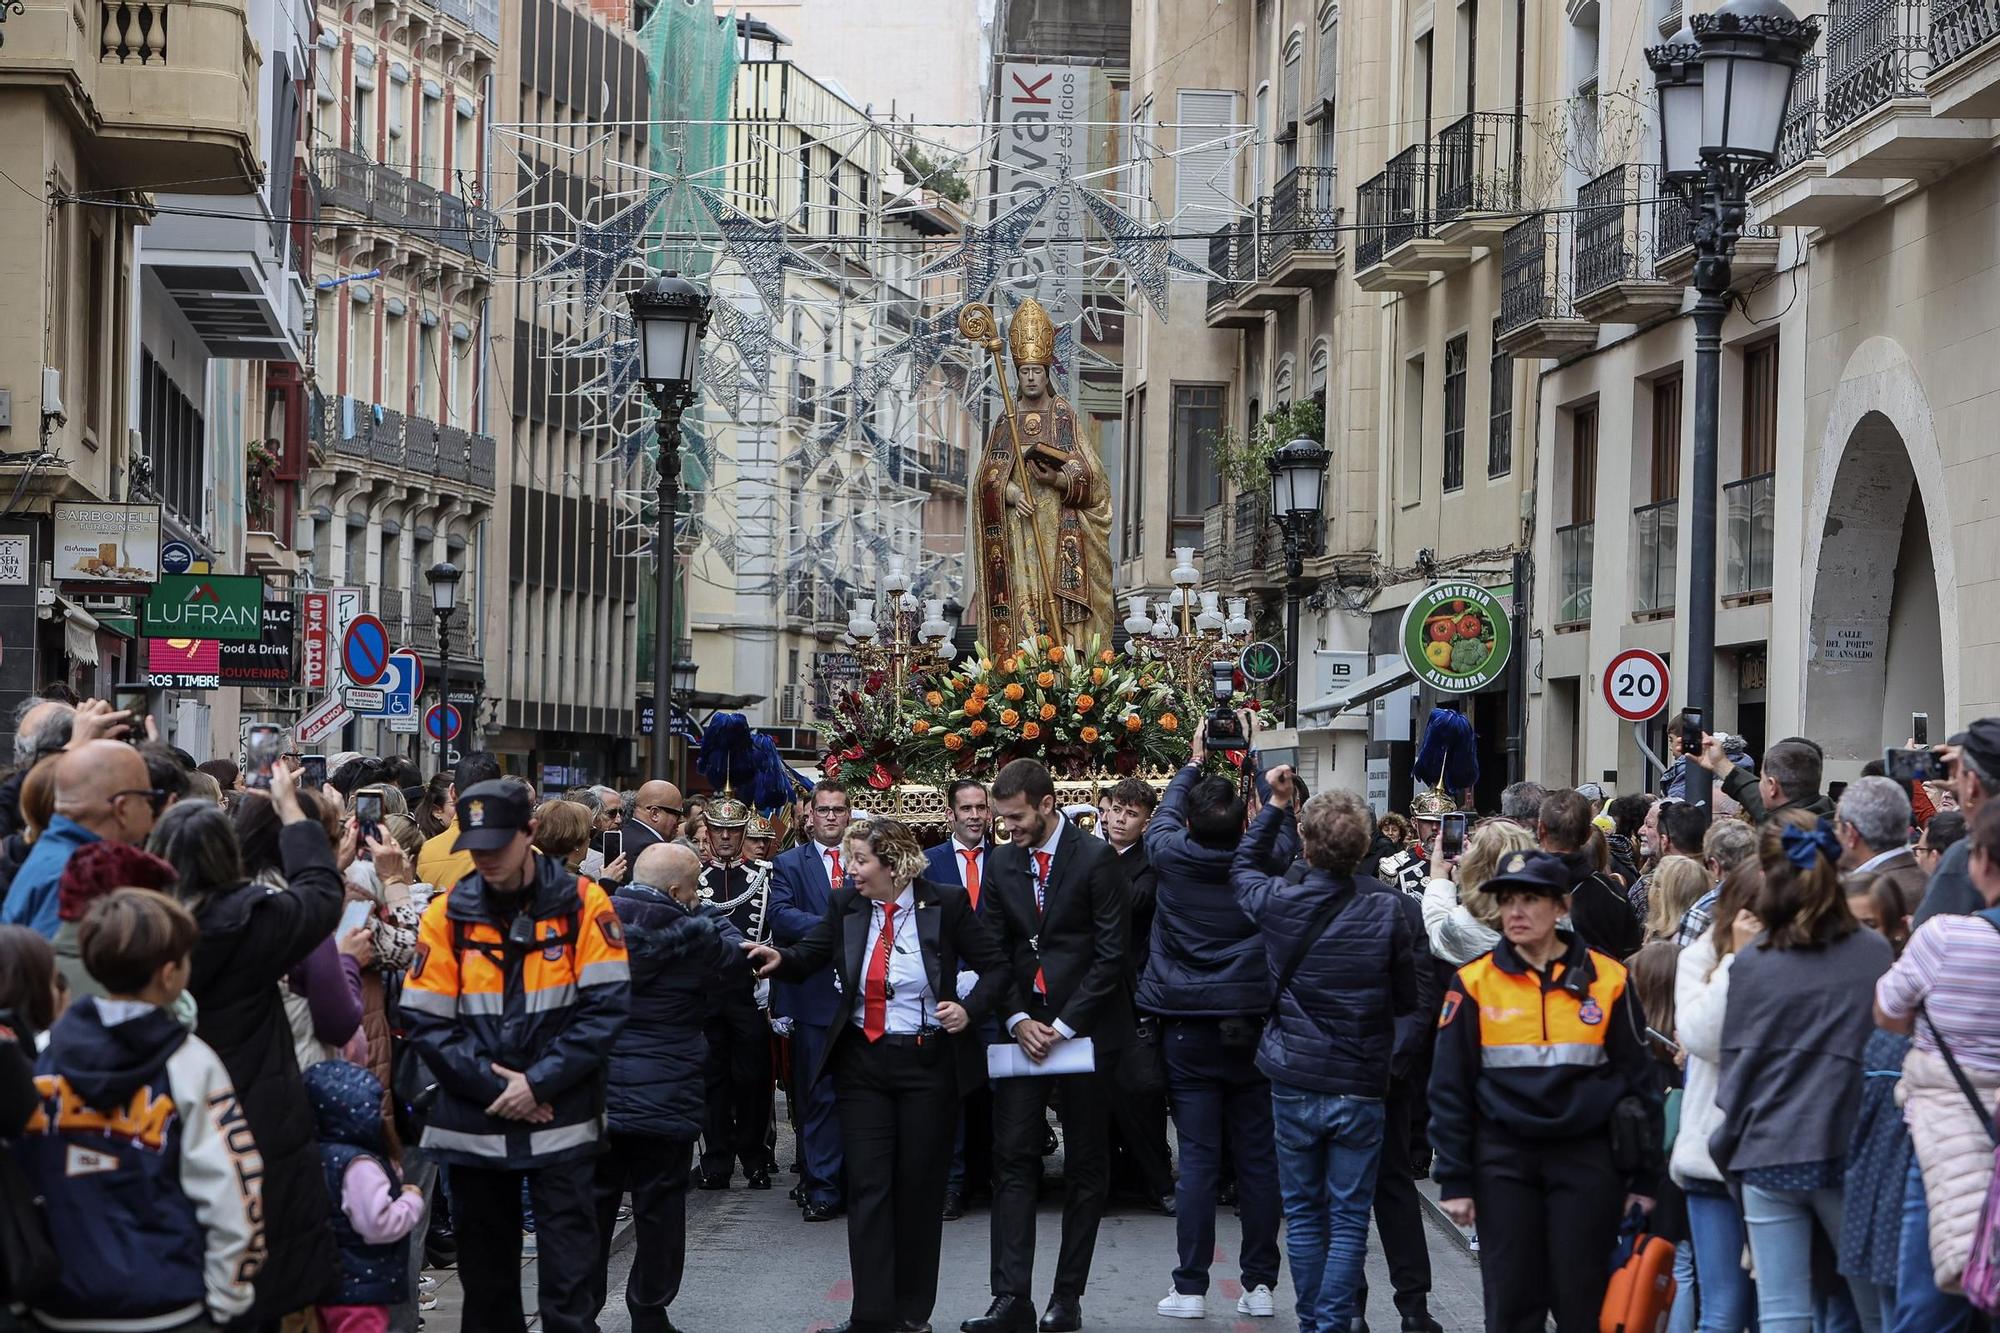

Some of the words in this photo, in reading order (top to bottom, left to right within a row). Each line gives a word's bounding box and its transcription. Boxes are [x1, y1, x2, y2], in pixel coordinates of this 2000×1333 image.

[56, 510, 159, 523] CARBONELL
[80, 522, 141, 532] TURRONES
[1428, 586, 1490, 607] FRUTERIA
[147, 603, 257, 626] LUFRAN
[307, 599, 323, 632] SEX
[1838, 630, 1863, 639] CALLE
[219, 643, 245, 654] Food
[248, 644, 257, 654] &
[260, 644, 289, 655] Drink
[1826, 640, 1840, 648] DEL
[1839, 650, 1873, 659] ANSALDO
[305, 639, 323, 684] SHOP
[219, 667, 289, 679] SOUVENIRS
[1426, 669, 1487, 689] ALTAMIRA
[1618, 674, 1656, 697] 20
[352, 691, 379, 699] RESERVADO
[306, 722, 323, 738] SEX
[322, 704, 343, 725] SHOP
